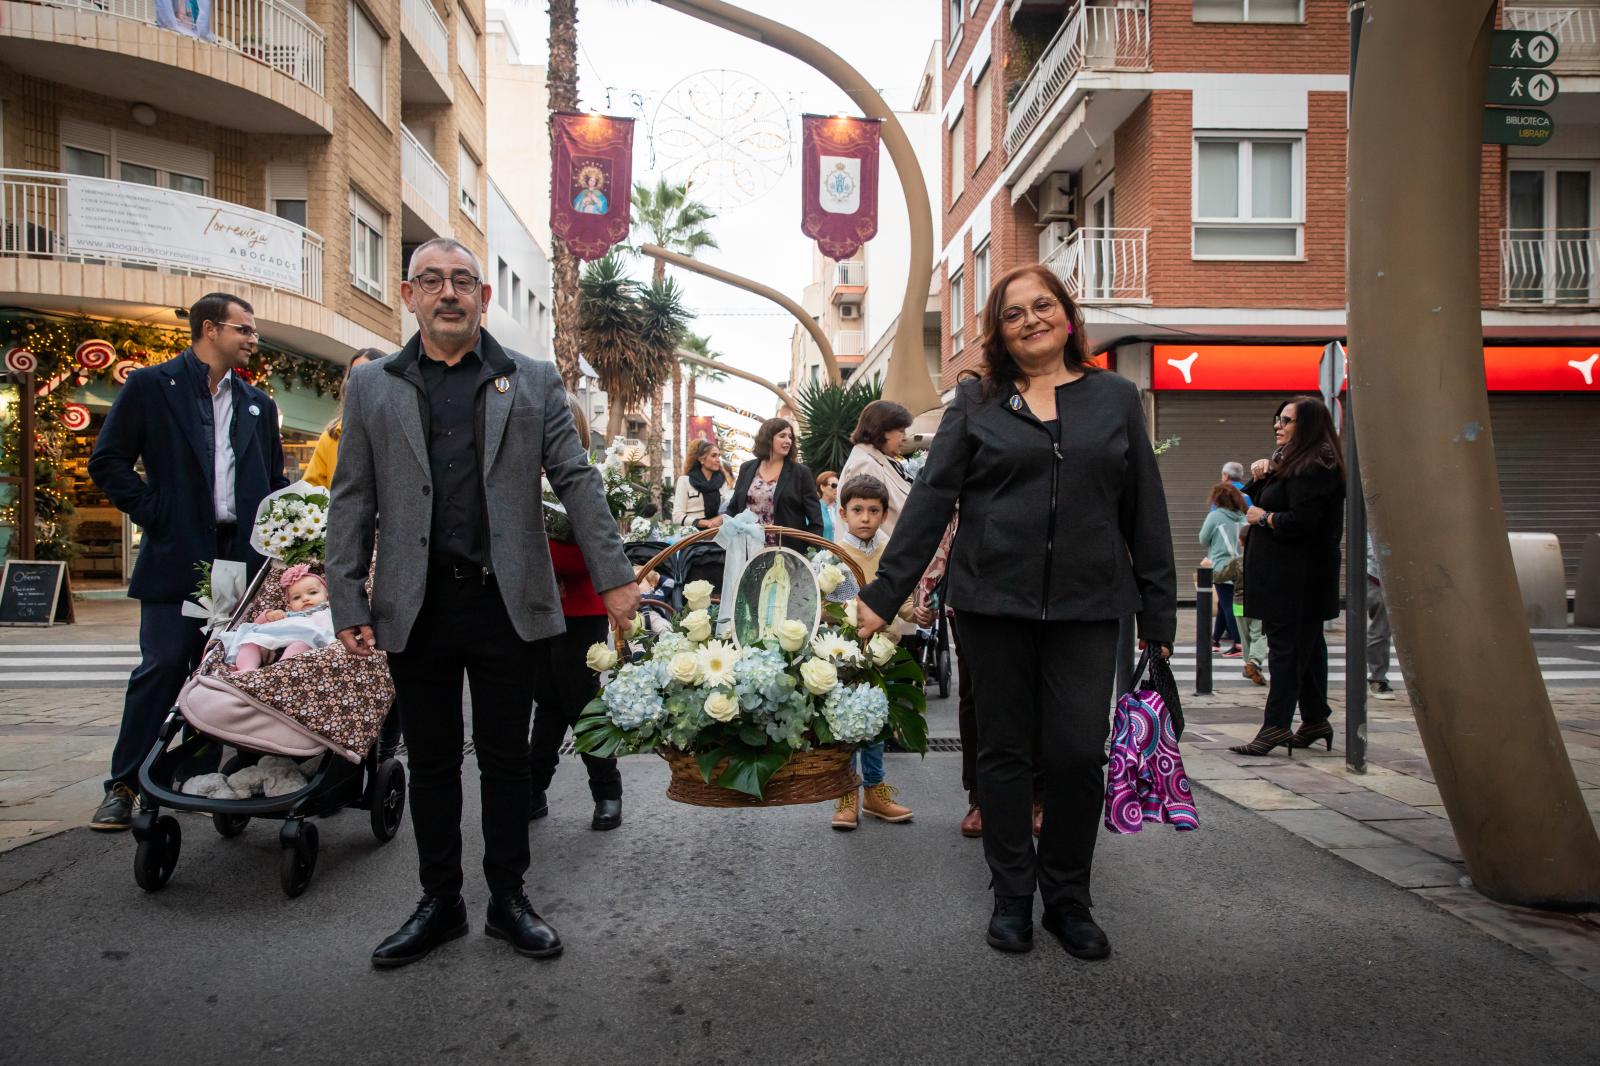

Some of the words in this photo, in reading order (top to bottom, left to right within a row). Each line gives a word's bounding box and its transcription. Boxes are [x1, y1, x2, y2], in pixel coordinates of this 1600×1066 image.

[1506, 115, 1550, 126] BIBLIOTECA
[1519, 129, 1549, 138] LIBRARY
[196, 206, 294, 248] Torrevieja
[230, 247, 297, 271] ABOGADOS
